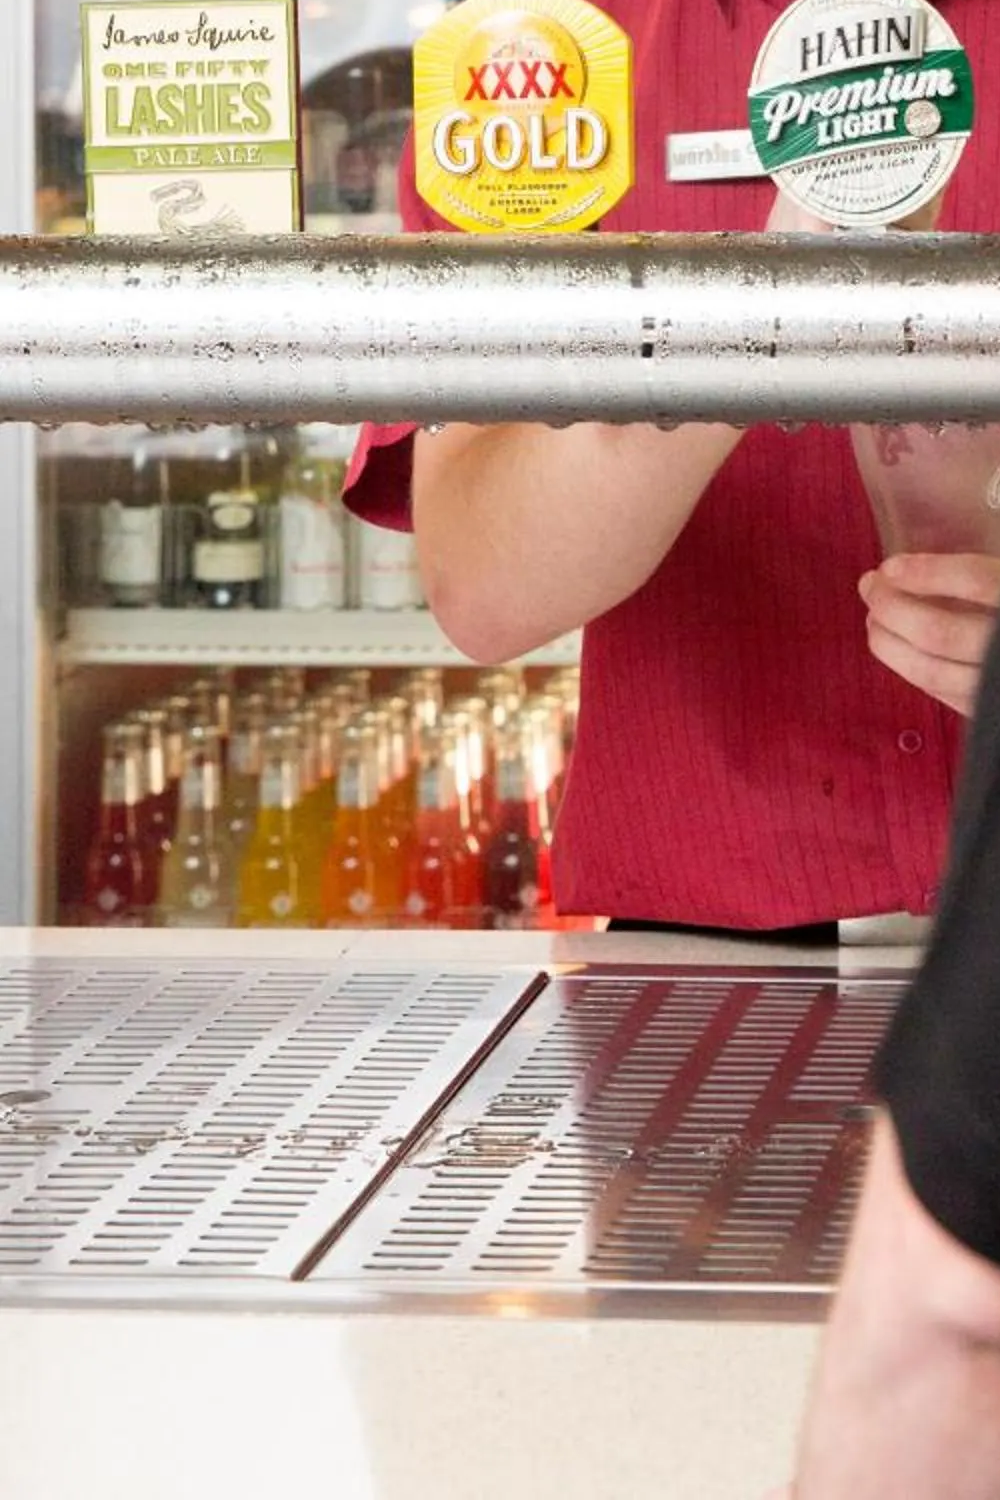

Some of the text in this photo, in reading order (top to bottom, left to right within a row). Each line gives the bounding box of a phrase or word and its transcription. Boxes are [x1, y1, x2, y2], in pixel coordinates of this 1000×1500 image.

[102, 11, 276, 51] James Squire
[800, 14, 913, 72] HAHN
[102, 59, 272, 80] ONE FIFTY
[464, 61, 575, 101] XXXX
[105, 81, 273, 137] LASHES
[763, 66, 958, 143] Premium
[433, 107, 610, 175] GOLD
[816, 107, 899, 147] LIGHT
[134, 147, 261, 167] PALE ALE
